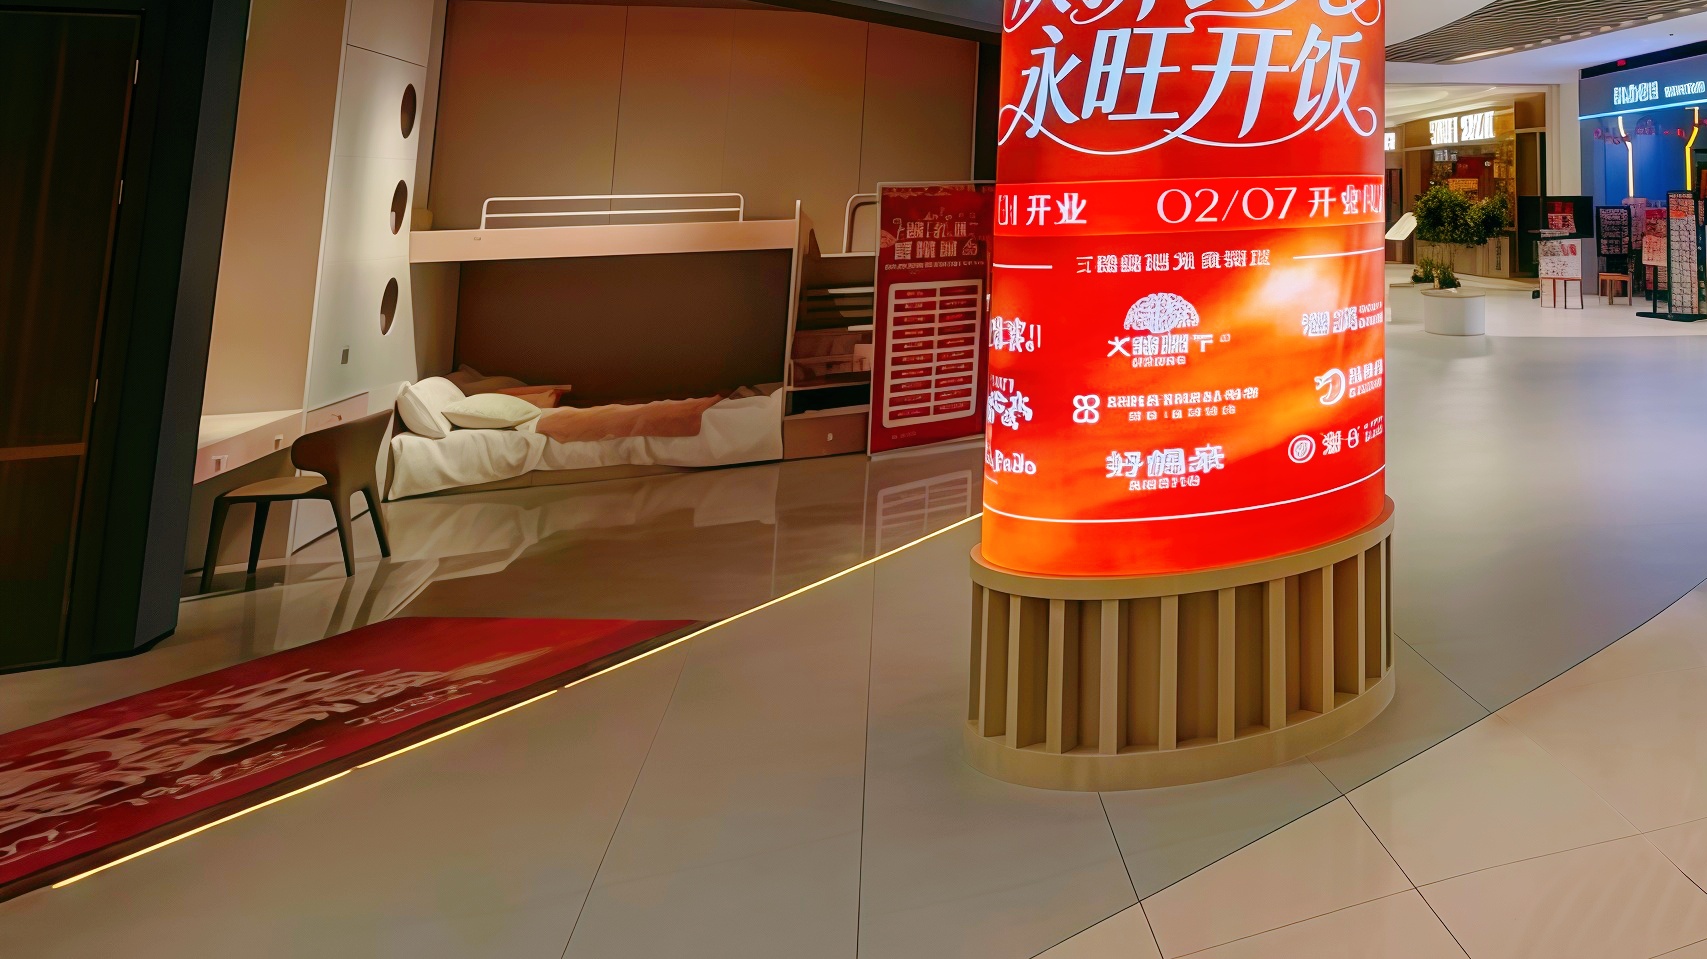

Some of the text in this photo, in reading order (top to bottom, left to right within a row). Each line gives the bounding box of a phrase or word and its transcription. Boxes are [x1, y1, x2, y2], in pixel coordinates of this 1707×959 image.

[999, 24, 1378, 155] 永旺开饭
[1157, 186, 1297, 224] 02/07
